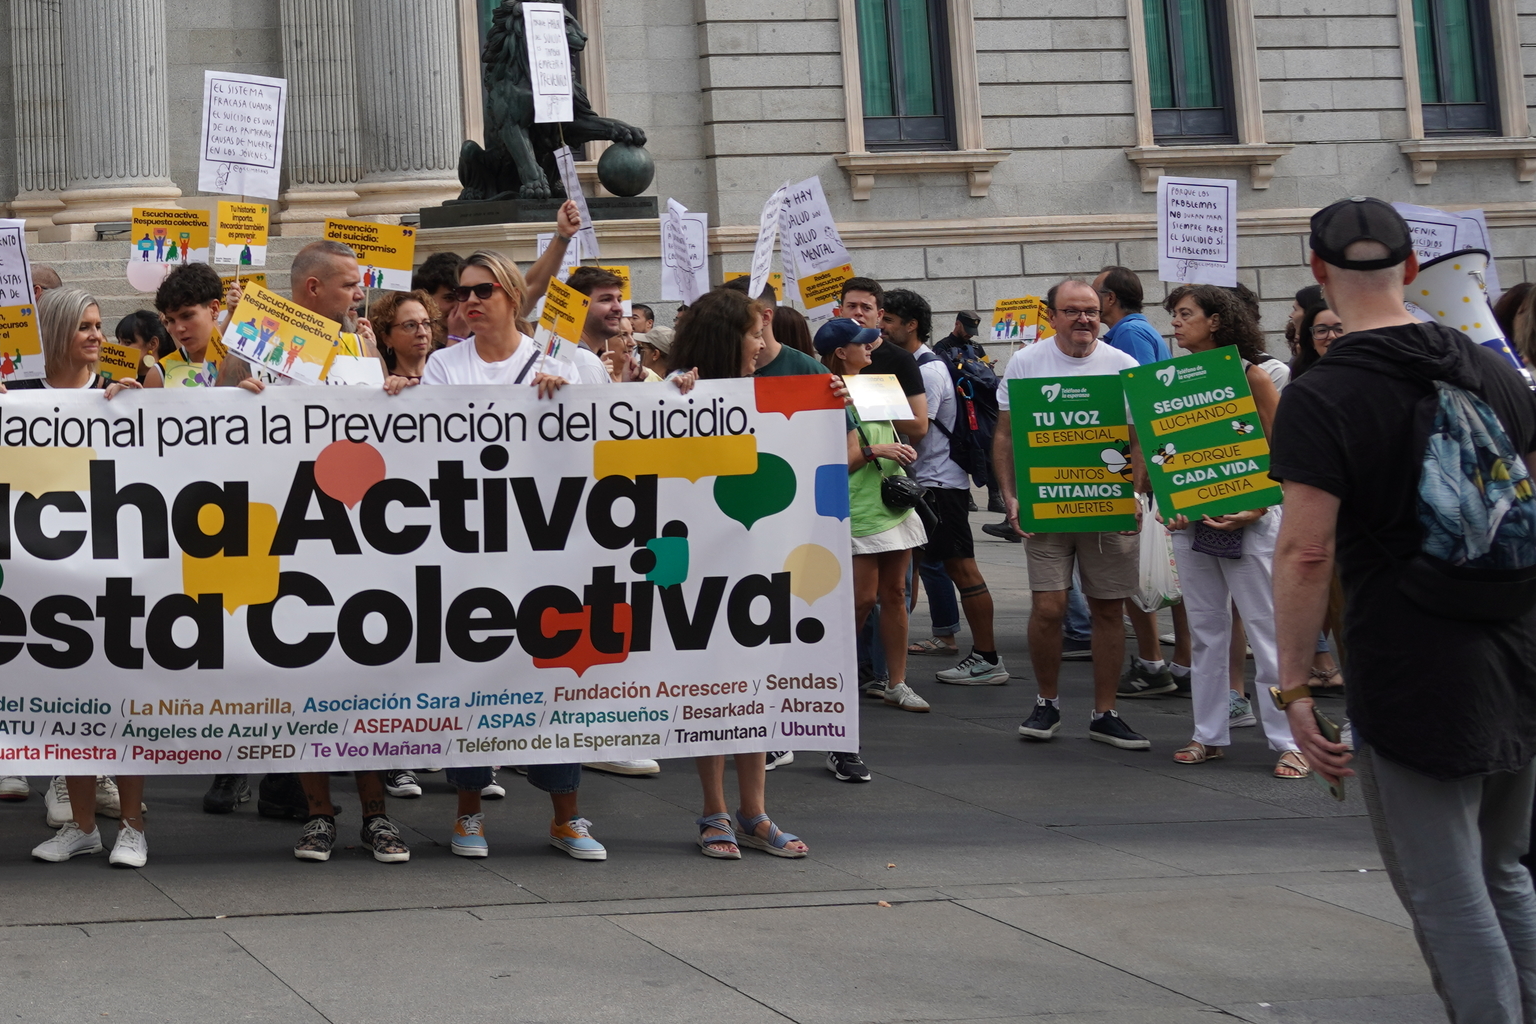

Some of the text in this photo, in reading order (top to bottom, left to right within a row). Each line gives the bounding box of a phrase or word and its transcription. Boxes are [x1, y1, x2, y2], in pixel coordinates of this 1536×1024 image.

[1171, 187, 1196, 197] PORQUE
[1172, 199, 1217, 209] PROBLEMAS
[174, 211, 199, 219] activa.
[1170, 211, 1181, 219] NO
[134, 218, 208, 227] Respuesta colectiva.
[329, 222, 378, 233] Prevención
[1173, 222, 1223, 233] SIEMPRE PERO
[343, 233, 378, 242] suicidio:
[1182, 234, 1213, 245] SUICIDIO
[10, 289, 19, 298] DE
[257, 289, 325, 329] Escucha activa.
[243, 293, 333, 342] Respuesta colectiva.
[1154, 387, 1235, 414] SEGUIMOS
[1033, 411, 1100, 426] TU VOZ
[1159, 403, 1237, 431] LUCHANDO
[158, 410, 249, 457] para
[262, 404, 293, 445] la
[304, 402, 526, 445] Prevención
[538, 402, 597, 441] del
[609, 399, 756, 439] Suicidio.
[1036, 429, 1115, 443] ES ESENCIAL
[1183, 445, 1241, 465] PORQUE
[1054, 469, 1104, 480] JUNTOS
[1172, 460, 1259, 486] CADA VIDA
[1039, 484, 1122, 498] EVITAMOS
[1198, 478, 1253, 499] CUENTA
[269, 445, 688, 557] Activa.
[1057, 501, 1114, 514] MUERTES
[247, 548, 825, 671] Colectiva.
[30, 696, 111, 714] Suicidio
[158, 698, 204, 716] Niña
[210, 697, 296, 717] Amarilla,
[302, 693, 411, 713] Asociación
[416, 692, 460, 710] Sara
[465, 688, 547, 708] Jiménez,
[554, 681, 651, 702] Fundación
[656, 678, 748, 699] Acrescere
[753, 678, 761, 695] y
[766, 672, 844, 693] Sendas)
[51, 721, 75, 736] AJ
[80, 722, 106, 736] 3C
[121, 720, 197, 742] Ángeles
[201, 723, 224, 738] de
[228, 723, 268, 738] Azul
[272, 725, 282, 740] y
[287, 721, 338, 736] Verde
[353, 717, 463, 734] ASEPADUAL
[478, 713, 536, 729] ASPAS
[550, 706, 669, 727] Atrapasueños
[683, 701, 764, 721] Besarkada
[781, 698, 845, 714] Abrazo
[44, 744, 117, 760] Finestra
[132, 745, 222, 764] Papageno
[237, 744, 296, 761] SEPED
[311, 743, 331, 758] Te
[336, 742, 369, 758] Veo
[373, 740, 441, 757] Mañana
[456, 736, 528, 753] Teléfono
[531, 734, 552, 749] de
[555, 733, 570, 748] la
[573, 731, 660, 752] Esperanza
[675, 725, 767, 744] Tramuntana
[781, 721, 846, 738] Ubuntu
